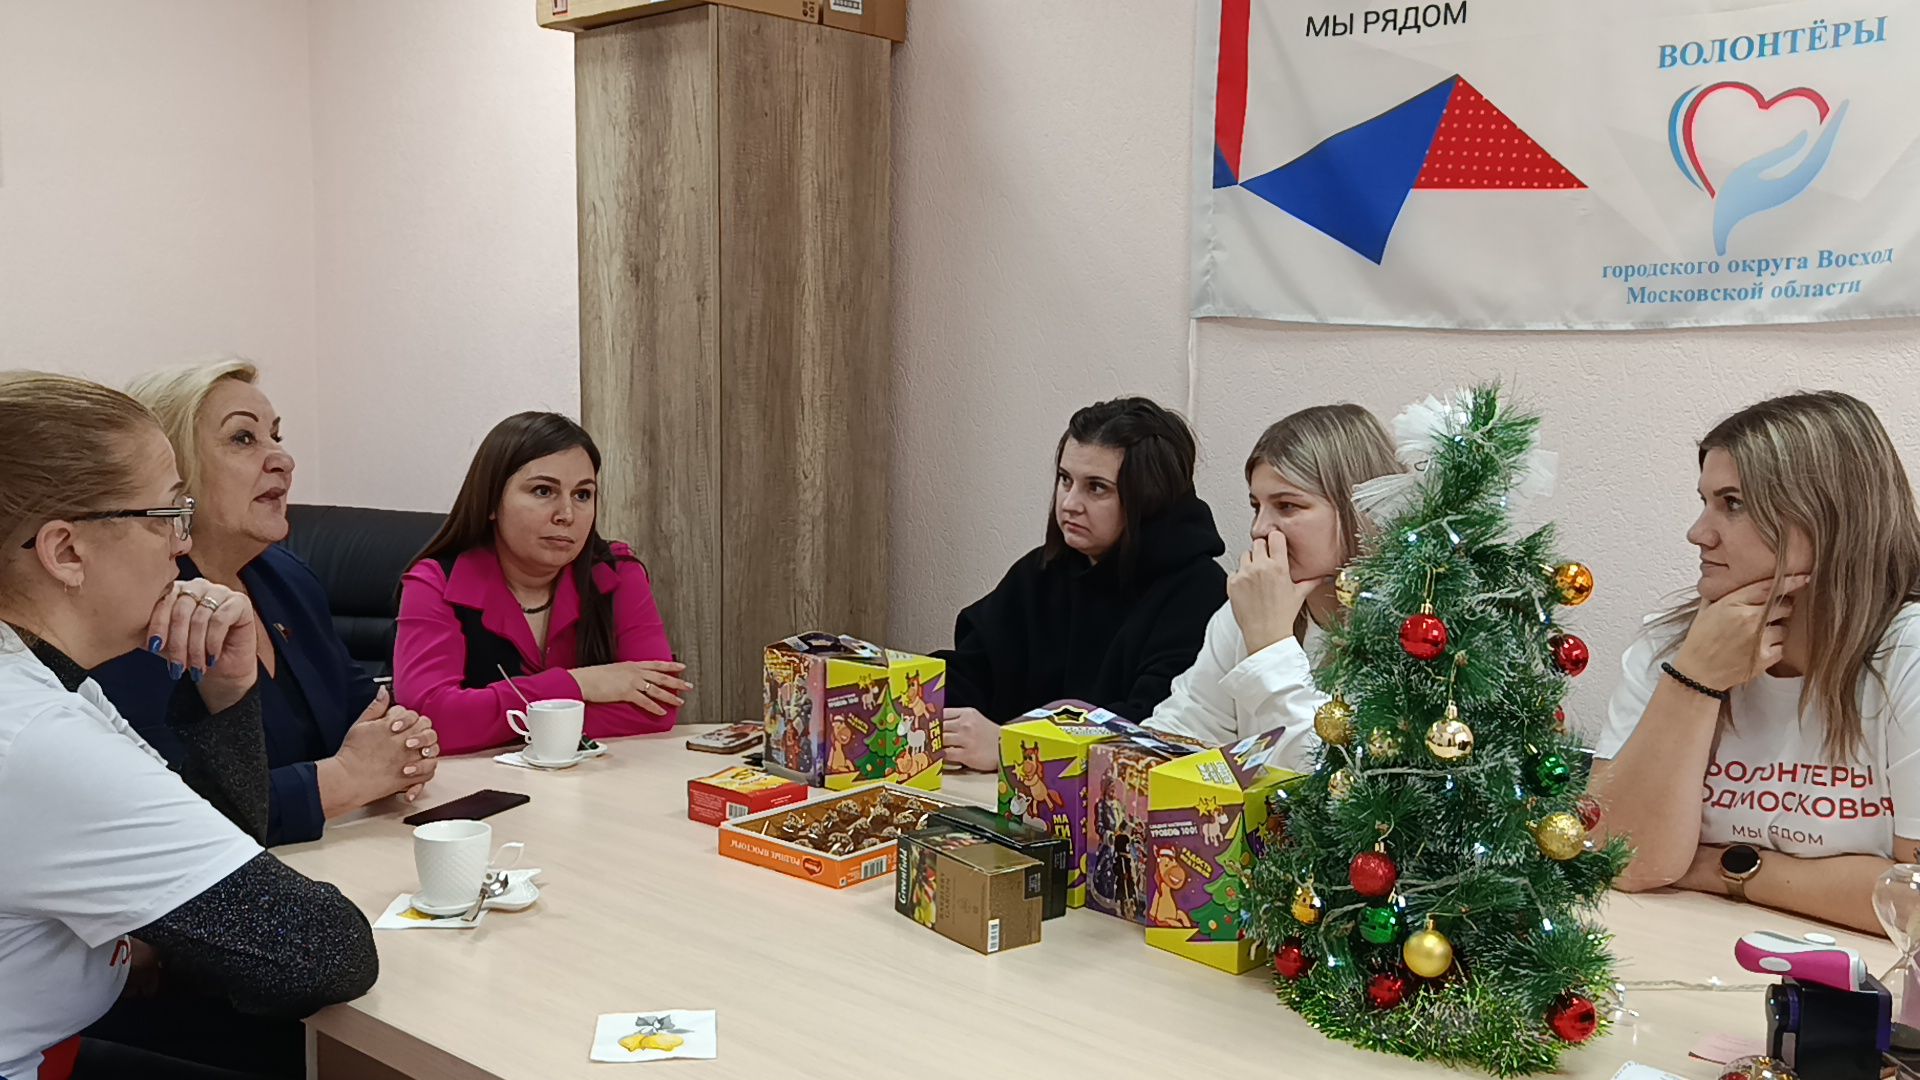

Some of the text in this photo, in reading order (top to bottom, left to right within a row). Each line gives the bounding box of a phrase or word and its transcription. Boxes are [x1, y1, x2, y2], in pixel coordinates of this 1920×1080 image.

[1305, 0, 1467, 37] МЫ РЯДОМ
[1657, 15, 1888, 69] ВОЛОНТЁРЫ
[1602, 247, 1894, 282] городского округа Восход
[1626, 279, 1862, 305] Московской области
[1702, 782, 1895, 819] ОДМОСКОВЬЯ
[1732, 824, 1824, 846] МЫ ЯДОМ
